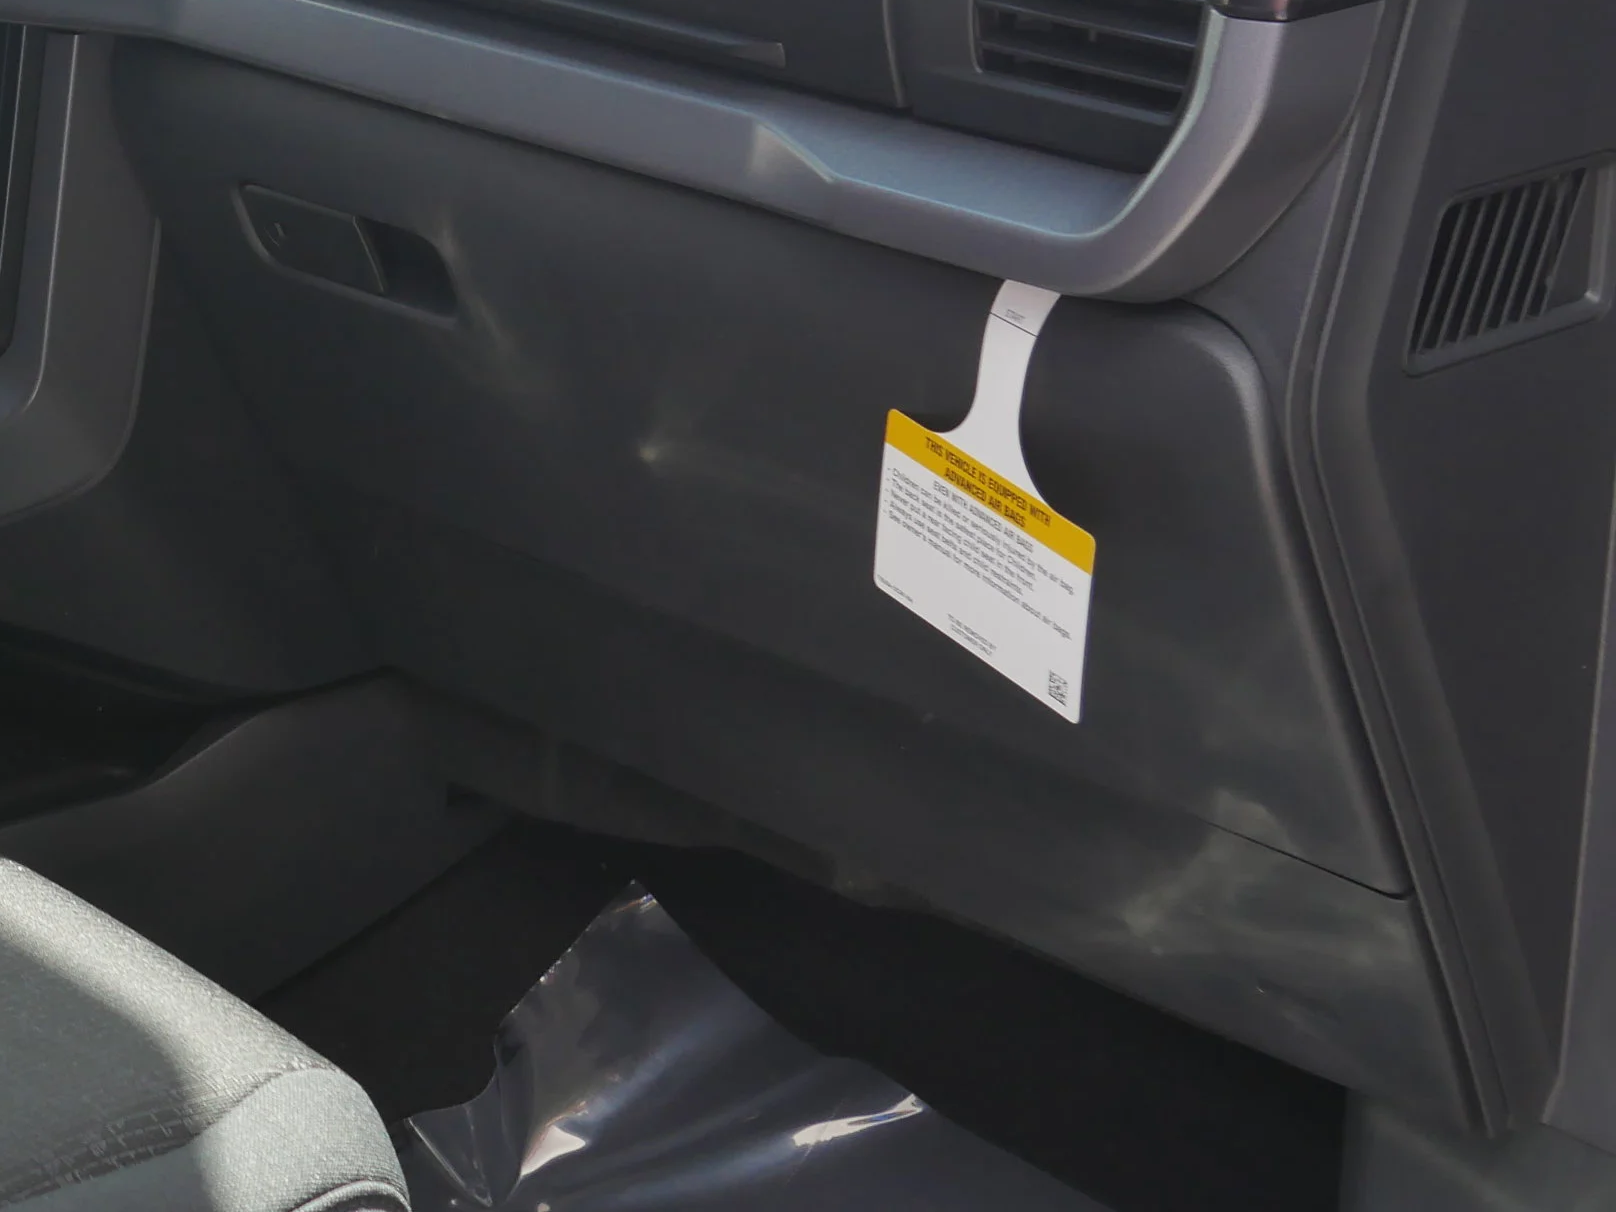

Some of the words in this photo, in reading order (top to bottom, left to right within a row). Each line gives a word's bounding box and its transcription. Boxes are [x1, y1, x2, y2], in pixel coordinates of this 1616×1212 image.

[925, 436, 942, 457] THIS
[945, 449, 976, 479] VEHICLE
[988, 477, 1026, 511] EQUIPPED
[1029, 503, 1050, 527] WITH
[944, 466, 986, 503] ADVANCED
[988, 495, 1002, 513] AIR
[1004, 505, 1026, 528] BAGS
